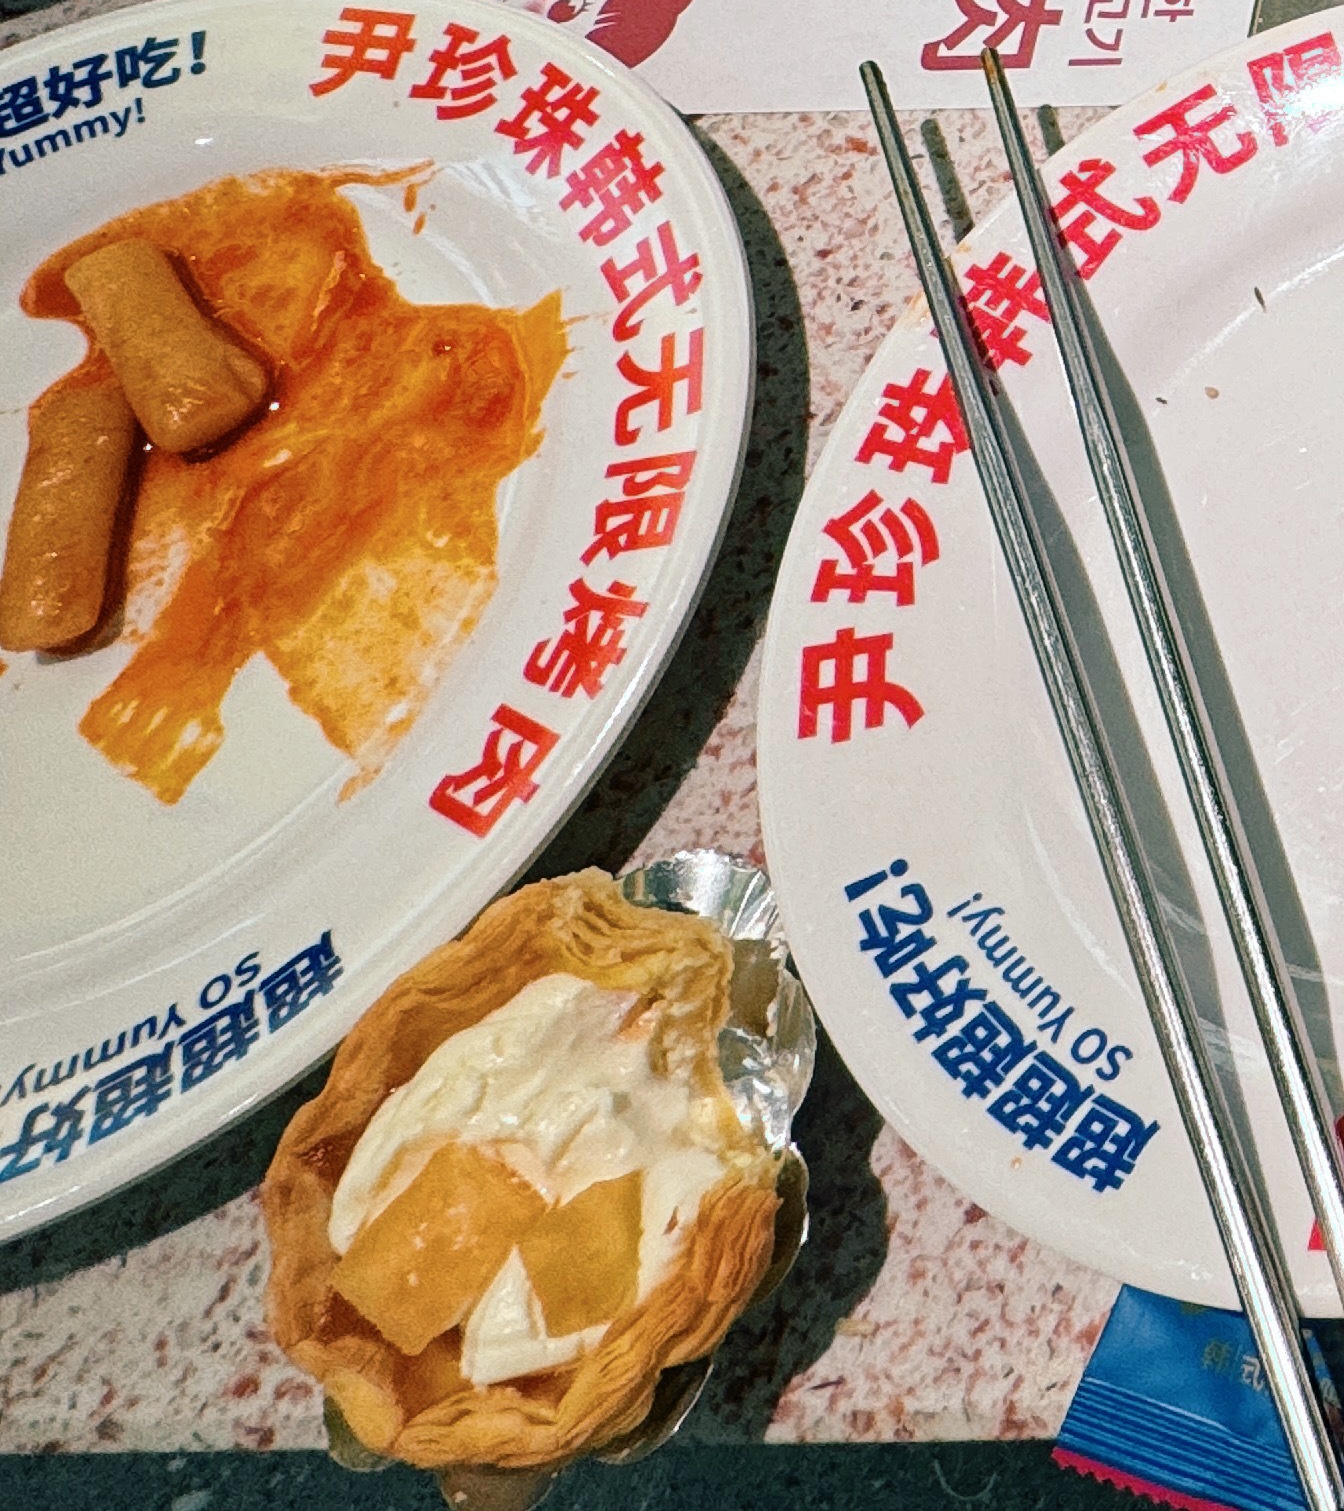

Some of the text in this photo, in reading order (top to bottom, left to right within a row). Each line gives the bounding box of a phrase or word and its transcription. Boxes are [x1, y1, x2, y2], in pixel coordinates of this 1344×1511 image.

[308, 7, 705, 838] 尹珍珠韩式无限烤肉
[199, 950, 261, 1012] SO
[843, 856, 1162, 1194] 超超超好吃!
[946, 891, 1133, 1083] SO Yummy!
